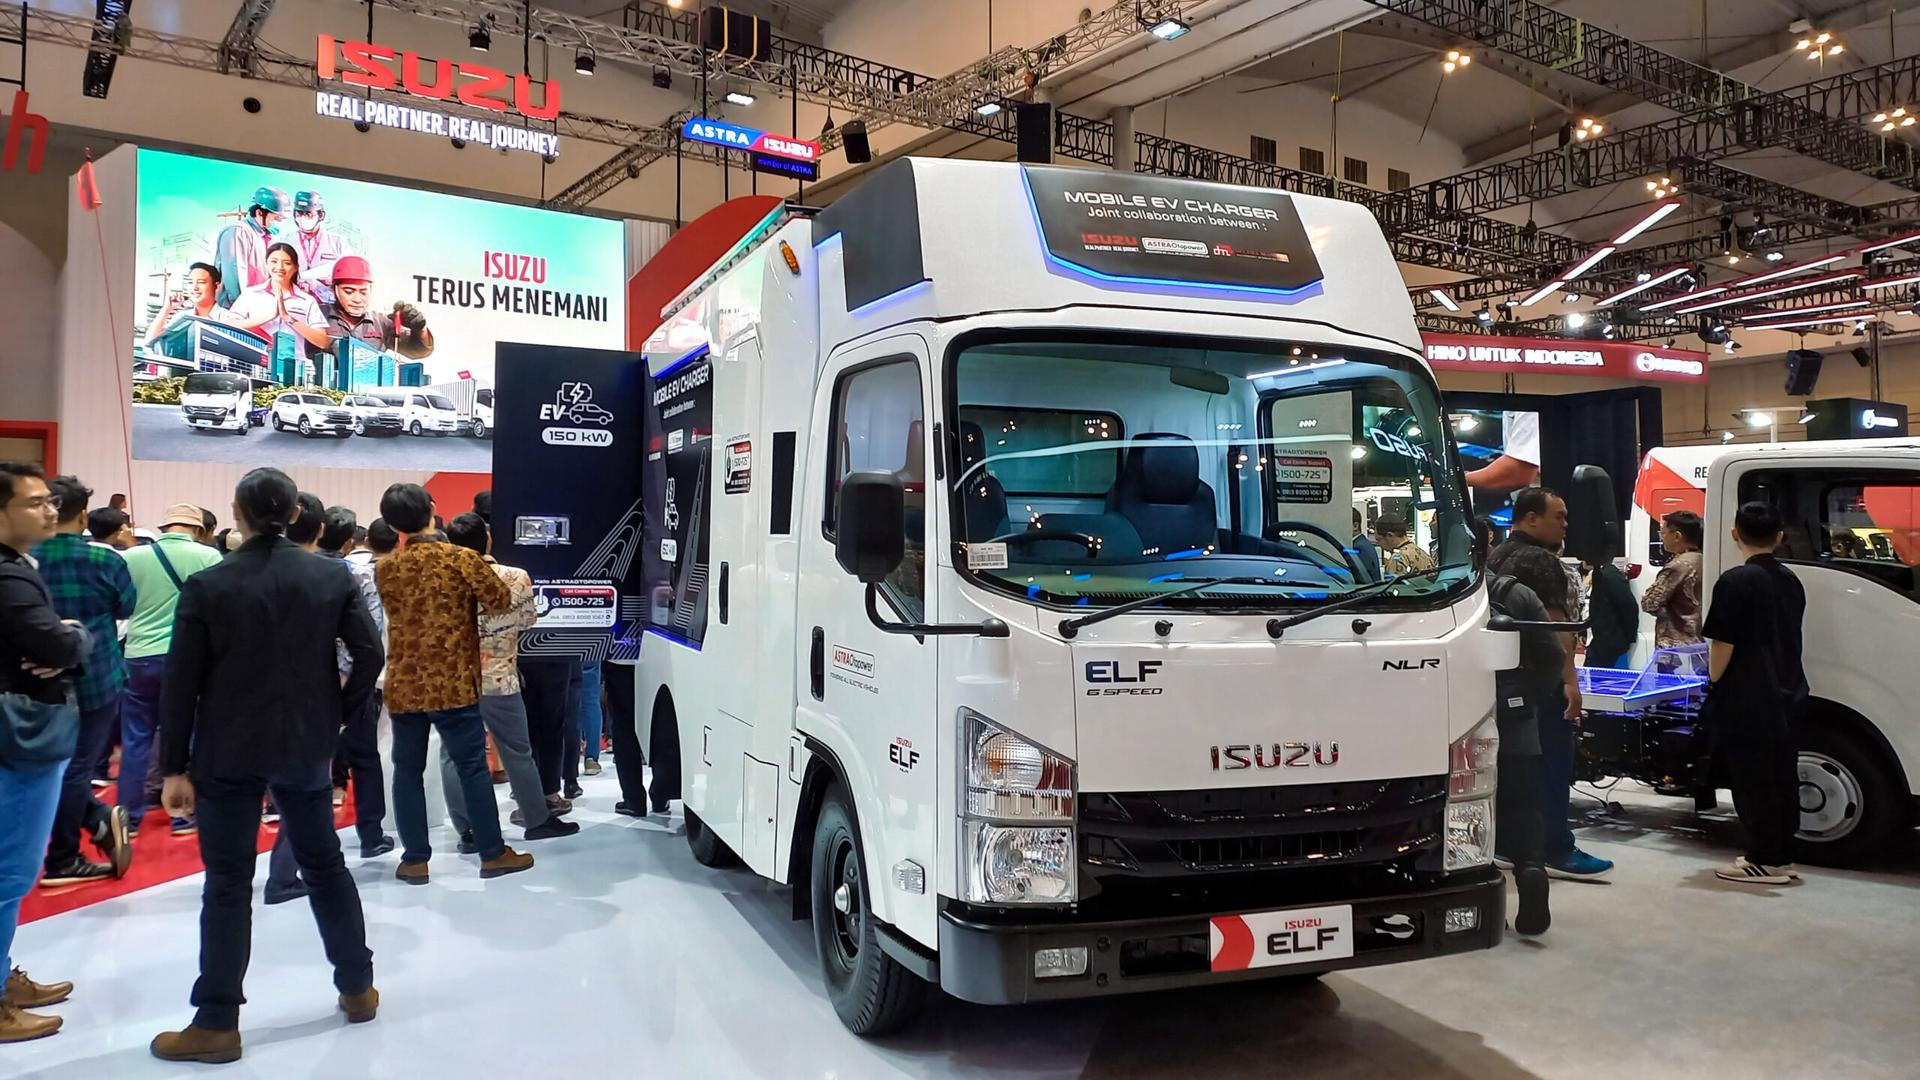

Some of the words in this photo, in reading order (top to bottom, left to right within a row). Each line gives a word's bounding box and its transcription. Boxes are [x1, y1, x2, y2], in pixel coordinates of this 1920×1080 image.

[317, 34, 560, 121] ISUZU
[317, 92, 364, 119] REAL
[365, 100, 447, 136] PARTNER.
[449, 116, 490, 144] REAL
[491, 126, 560, 156] JOURNEY.
[691, 123, 750, 146] ASTRA
[763, 138, 813, 158] ISUZU
[791, 163, 813, 175] ASTRA
[1064, 191, 1147, 207] MOBILE
[1152, 197, 1183, 209] EV
[1185, 200, 1279, 221] CHARGER
[1088, 206, 1121, 218] Joint
[1124, 209, 1206, 225] collaboration
[1209, 215, 1259, 230] between
[1081, 233, 1138, 246] ISUZU
[484, 250, 546, 284] ISUZU
[412, 274, 485, 309] TERUS
[492, 284, 608, 322] MENEMANI
[1428, 345, 1467, 361] HINO
[1469, 346, 1523, 363] UNTUK
[1525, 349, 1604, 366] INDONESIA
[539, 403, 567, 421] EV
[549, 431, 577, 442] 150
[581, 432, 608, 442] kW
[1281, 470, 1321, 479] 1500-725
[1694, 466, 1709, 479] RE
[561, 597, 605, 606] 1500-725
[1085, 660, 1163, 683] ELF
[1382, 658, 1440, 671] NLR
[1103, 687, 1163, 696] SPEED
[889, 743, 920, 769] ELF
[1210, 740, 1339, 771] ISUZU
[1285, 918, 1322, 930] ISUZU
[1267, 927, 1339, 956] ELF
